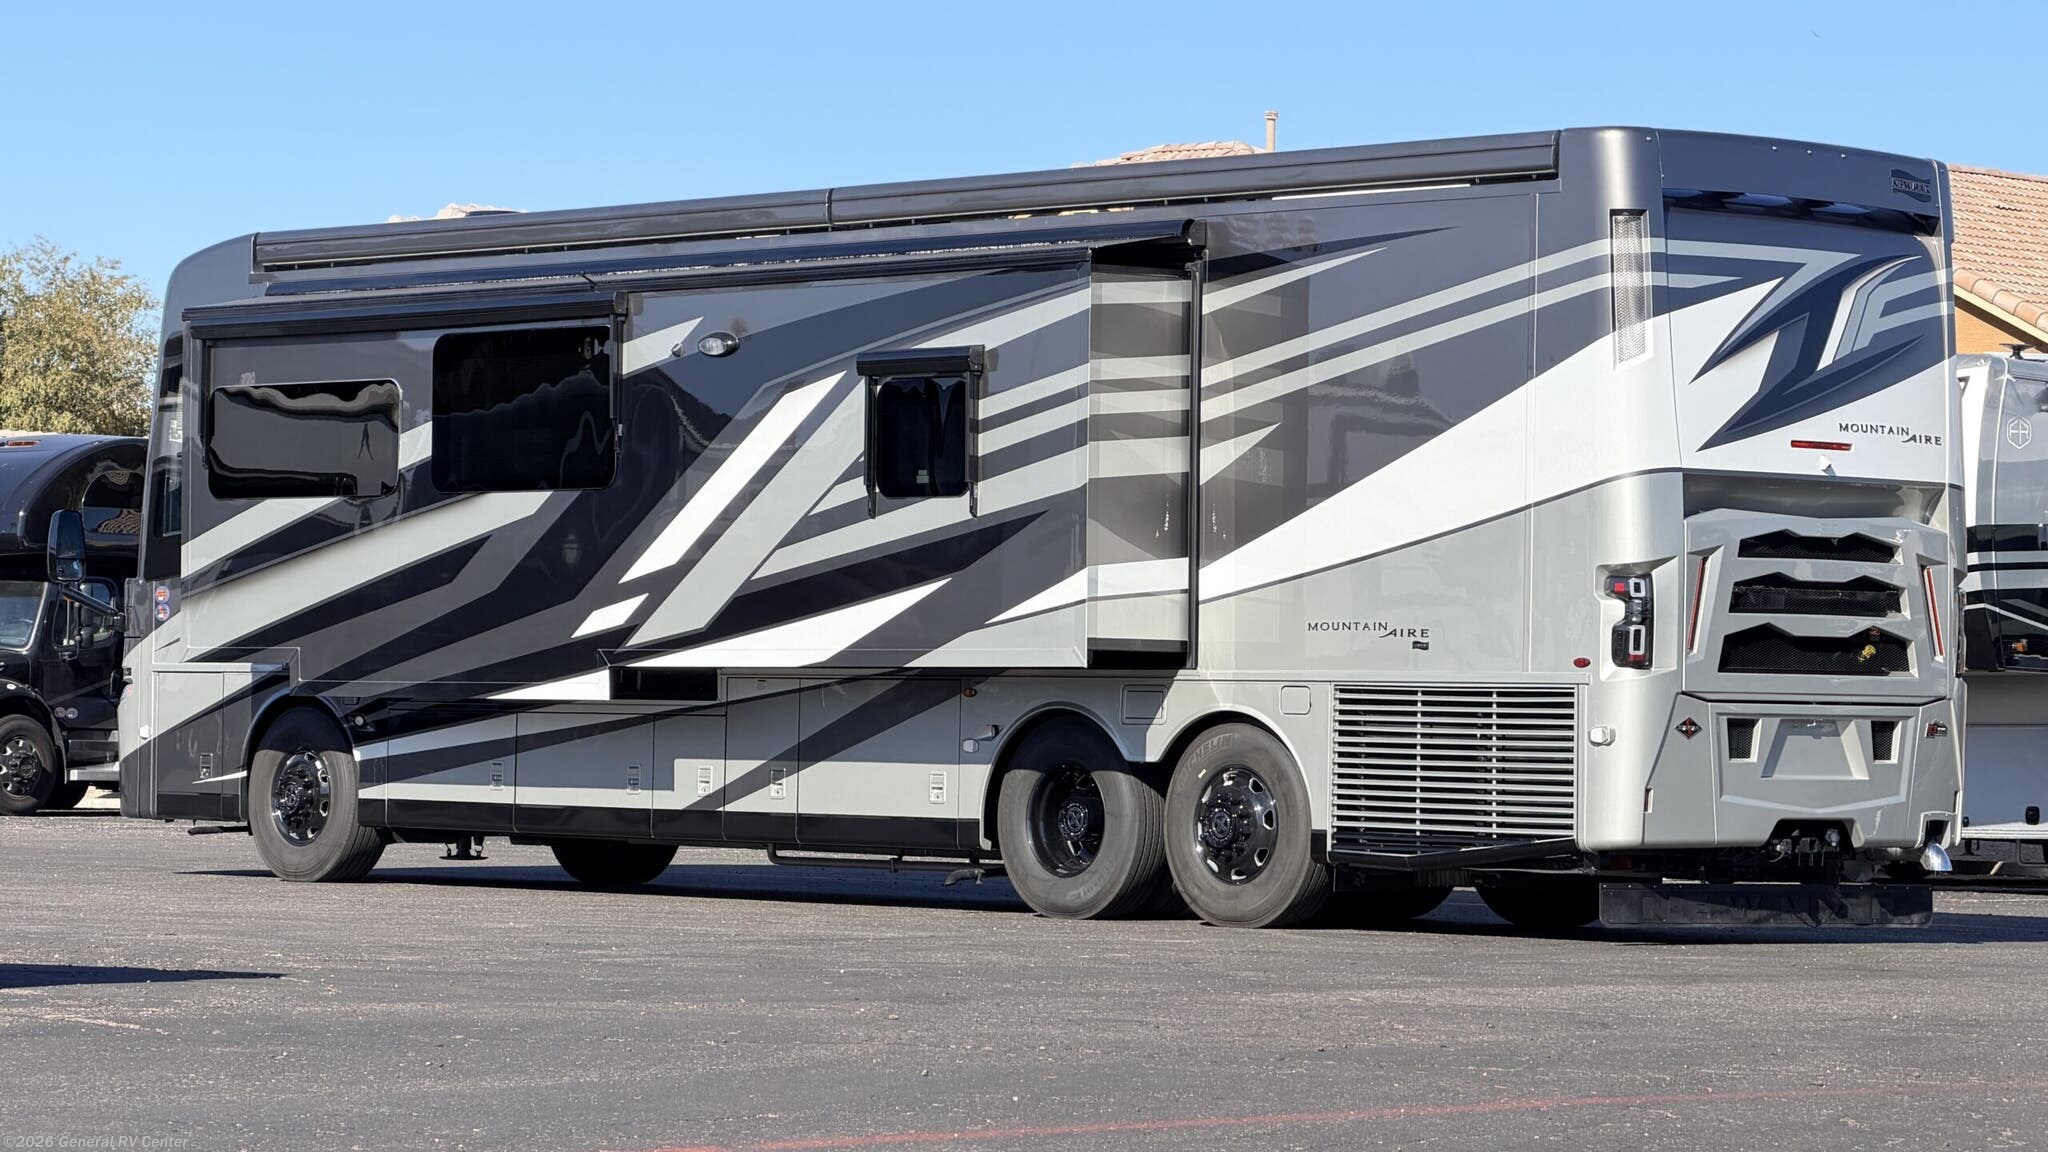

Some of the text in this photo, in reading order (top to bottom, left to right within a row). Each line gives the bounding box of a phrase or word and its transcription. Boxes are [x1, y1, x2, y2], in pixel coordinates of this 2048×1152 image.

[1839, 423, 1942, 446] MOUNTAIN AIRE
[1307, 621, 1430, 639] MOUNTAIN AIRE
